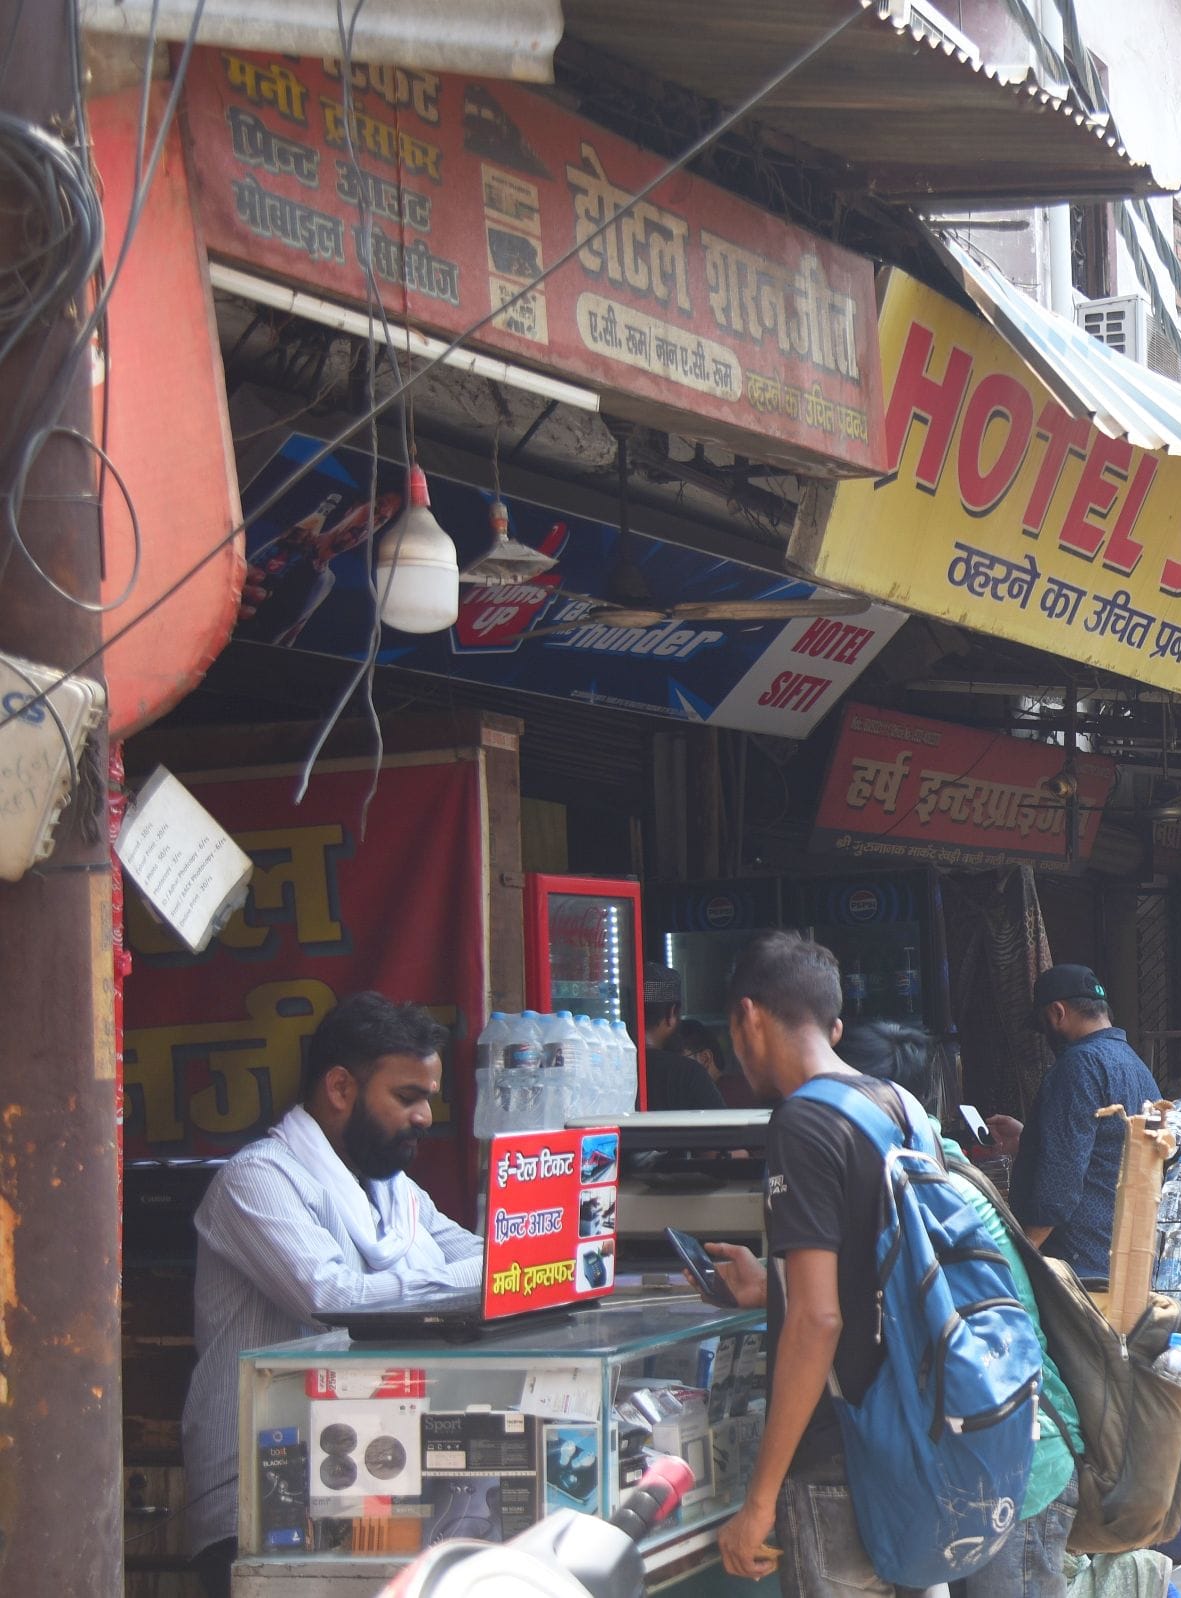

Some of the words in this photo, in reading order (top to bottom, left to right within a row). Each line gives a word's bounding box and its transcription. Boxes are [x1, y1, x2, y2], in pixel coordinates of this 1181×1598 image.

[566, 142, 690, 317] होटल
[878, 321, 1160, 576] HOTEL
[947, 540, 1040, 610] ठहरने
[1041, 575, 1088, 627] का
[1083, 589, 1155, 650] उचित
[791, 617, 875, 666] HOTEL
[757, 671, 832, 713] SIFTI
[846, 751, 912, 814] हर्ष
[498, 1153, 538, 1188] ई-रेल
[540, 1149, 575, 1179] टिकट
[528, 1208, 564, 1237] आउट
[493, 1262, 521, 1295] मनी
[425, 1416, 462, 1434] Sport
